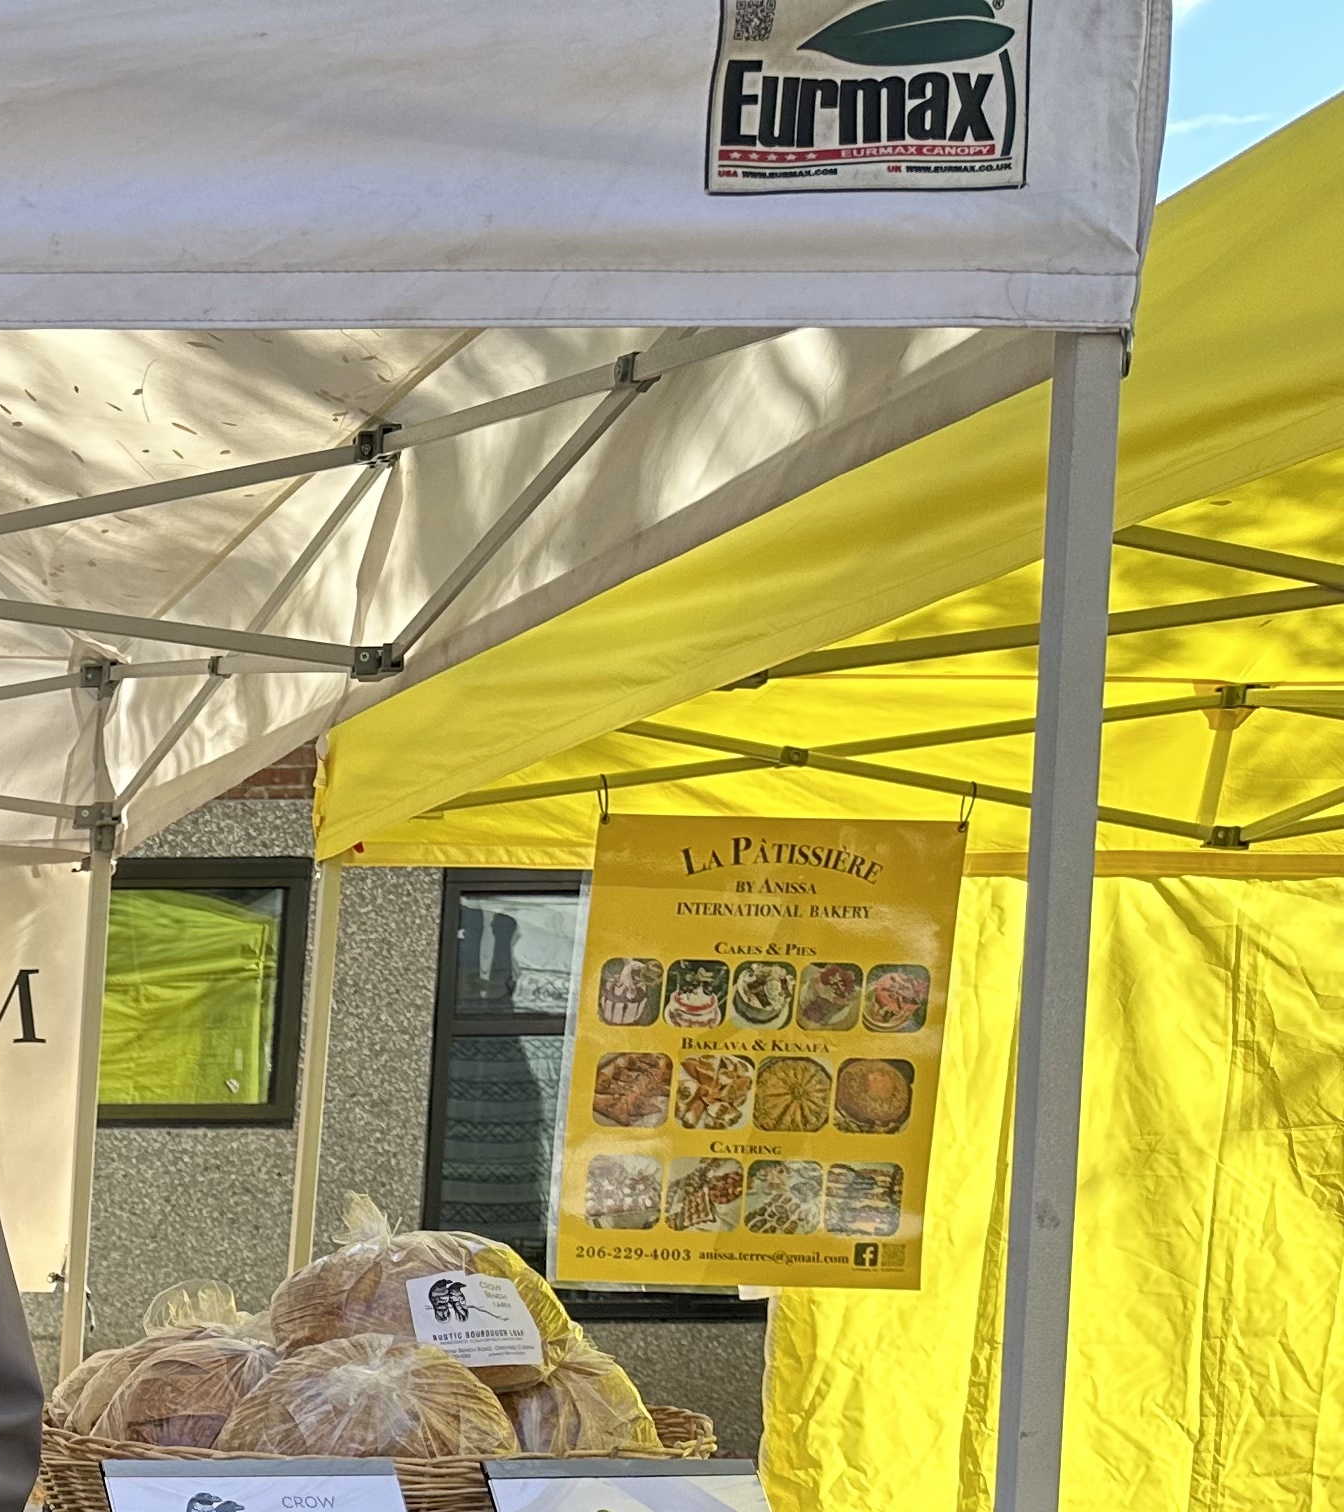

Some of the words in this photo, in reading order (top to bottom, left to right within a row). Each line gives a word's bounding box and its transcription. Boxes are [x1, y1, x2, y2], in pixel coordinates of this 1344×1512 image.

[721, 60, 994, 147] Eurmax
[841, 146, 918, 158] EURMAX
[922, 145, 991, 156] CANOPY
[718, 170, 738, 178] USA
[887, 165, 902, 173] UK
[735, 880, 756, 893] BY
[677, 902, 803, 918] INTERNATIONAL
[809, 904, 873, 919] BAKERY
[766, 942, 783, 956] &
[751, 1038, 768, 1052] &
[710, 1141, 782, 1156] CATERING
[576, 1245, 691, 1261] 206-229-4003
[282, 1496, 335, 1508] CROW
